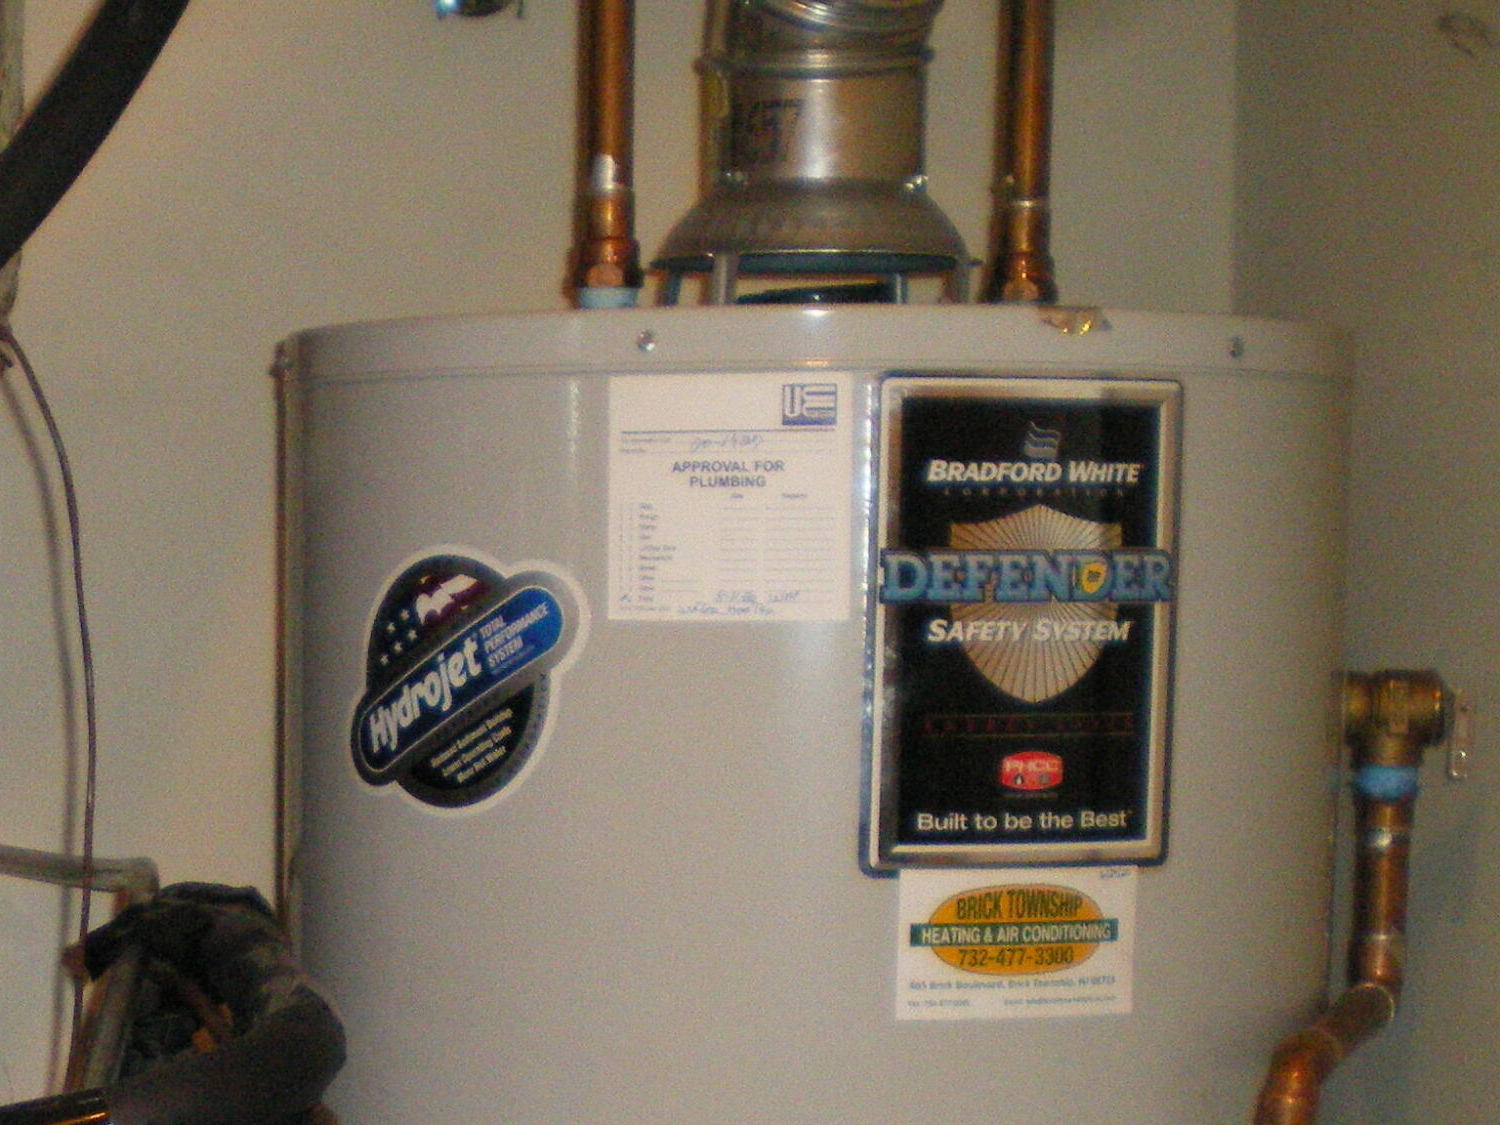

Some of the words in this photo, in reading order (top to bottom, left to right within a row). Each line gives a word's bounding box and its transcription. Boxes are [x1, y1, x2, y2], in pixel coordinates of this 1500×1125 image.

[672, 460, 747, 472] APPROVAL
[755, 460, 784, 472] FOR
[927, 459, 1062, 483] BRADFORD
[1069, 460, 1141, 483] WHITE
[689, 476, 766, 487] PLUMBING
[882, 552, 1173, 602] DEFENDER
[927, 619, 1026, 643] SAFETY
[1032, 618, 1132, 643] SYSTEM
[369, 635, 483, 754] Hydrojet
[917, 812, 968, 831] Built
[975, 814, 998, 830] to
[1005, 812, 1032, 831] be
[1039, 812, 1074, 830] the
[1081, 811, 1127, 830] Best
[957, 892, 1002, 920] BRICK
[1007, 889, 1082, 918] TOWNSHIP
[922, 928, 980, 945] HEATING
[984, 928, 993, 943] &
[996, 926, 1019, 943] AIR
[1022, 922, 1111, 943] CONDITIONING
